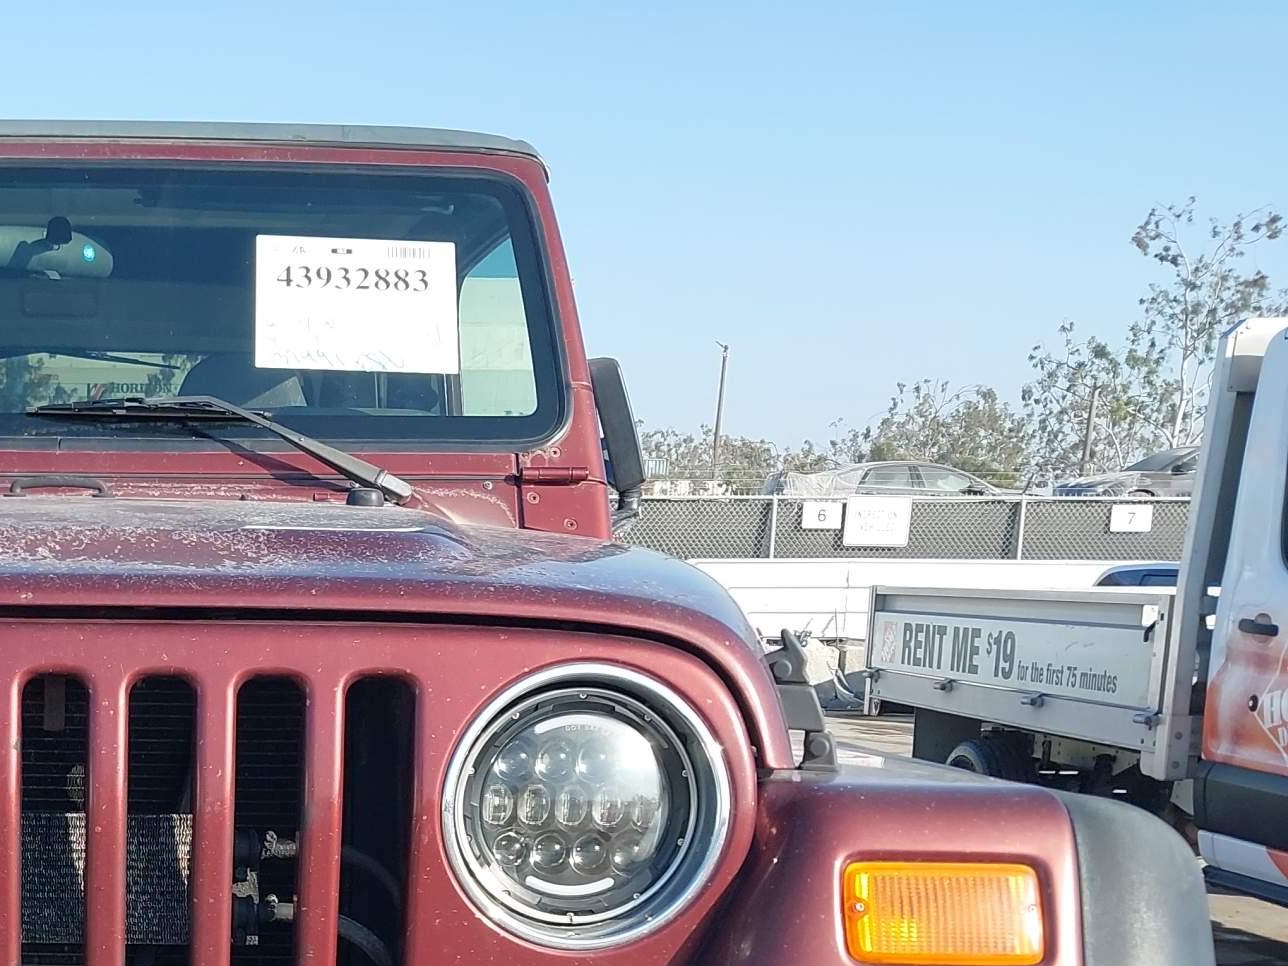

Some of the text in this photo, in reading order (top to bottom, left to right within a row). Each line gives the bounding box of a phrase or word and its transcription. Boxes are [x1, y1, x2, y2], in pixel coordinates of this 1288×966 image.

[276, 265, 429, 292] 43932883
[112, 383, 172, 394] HORION
[818, 509, 826, 521] 6
[1128, 512, 1137, 525] 7
[901, 622, 1118, 694] RENT ME $19 for the first 75 minutes
